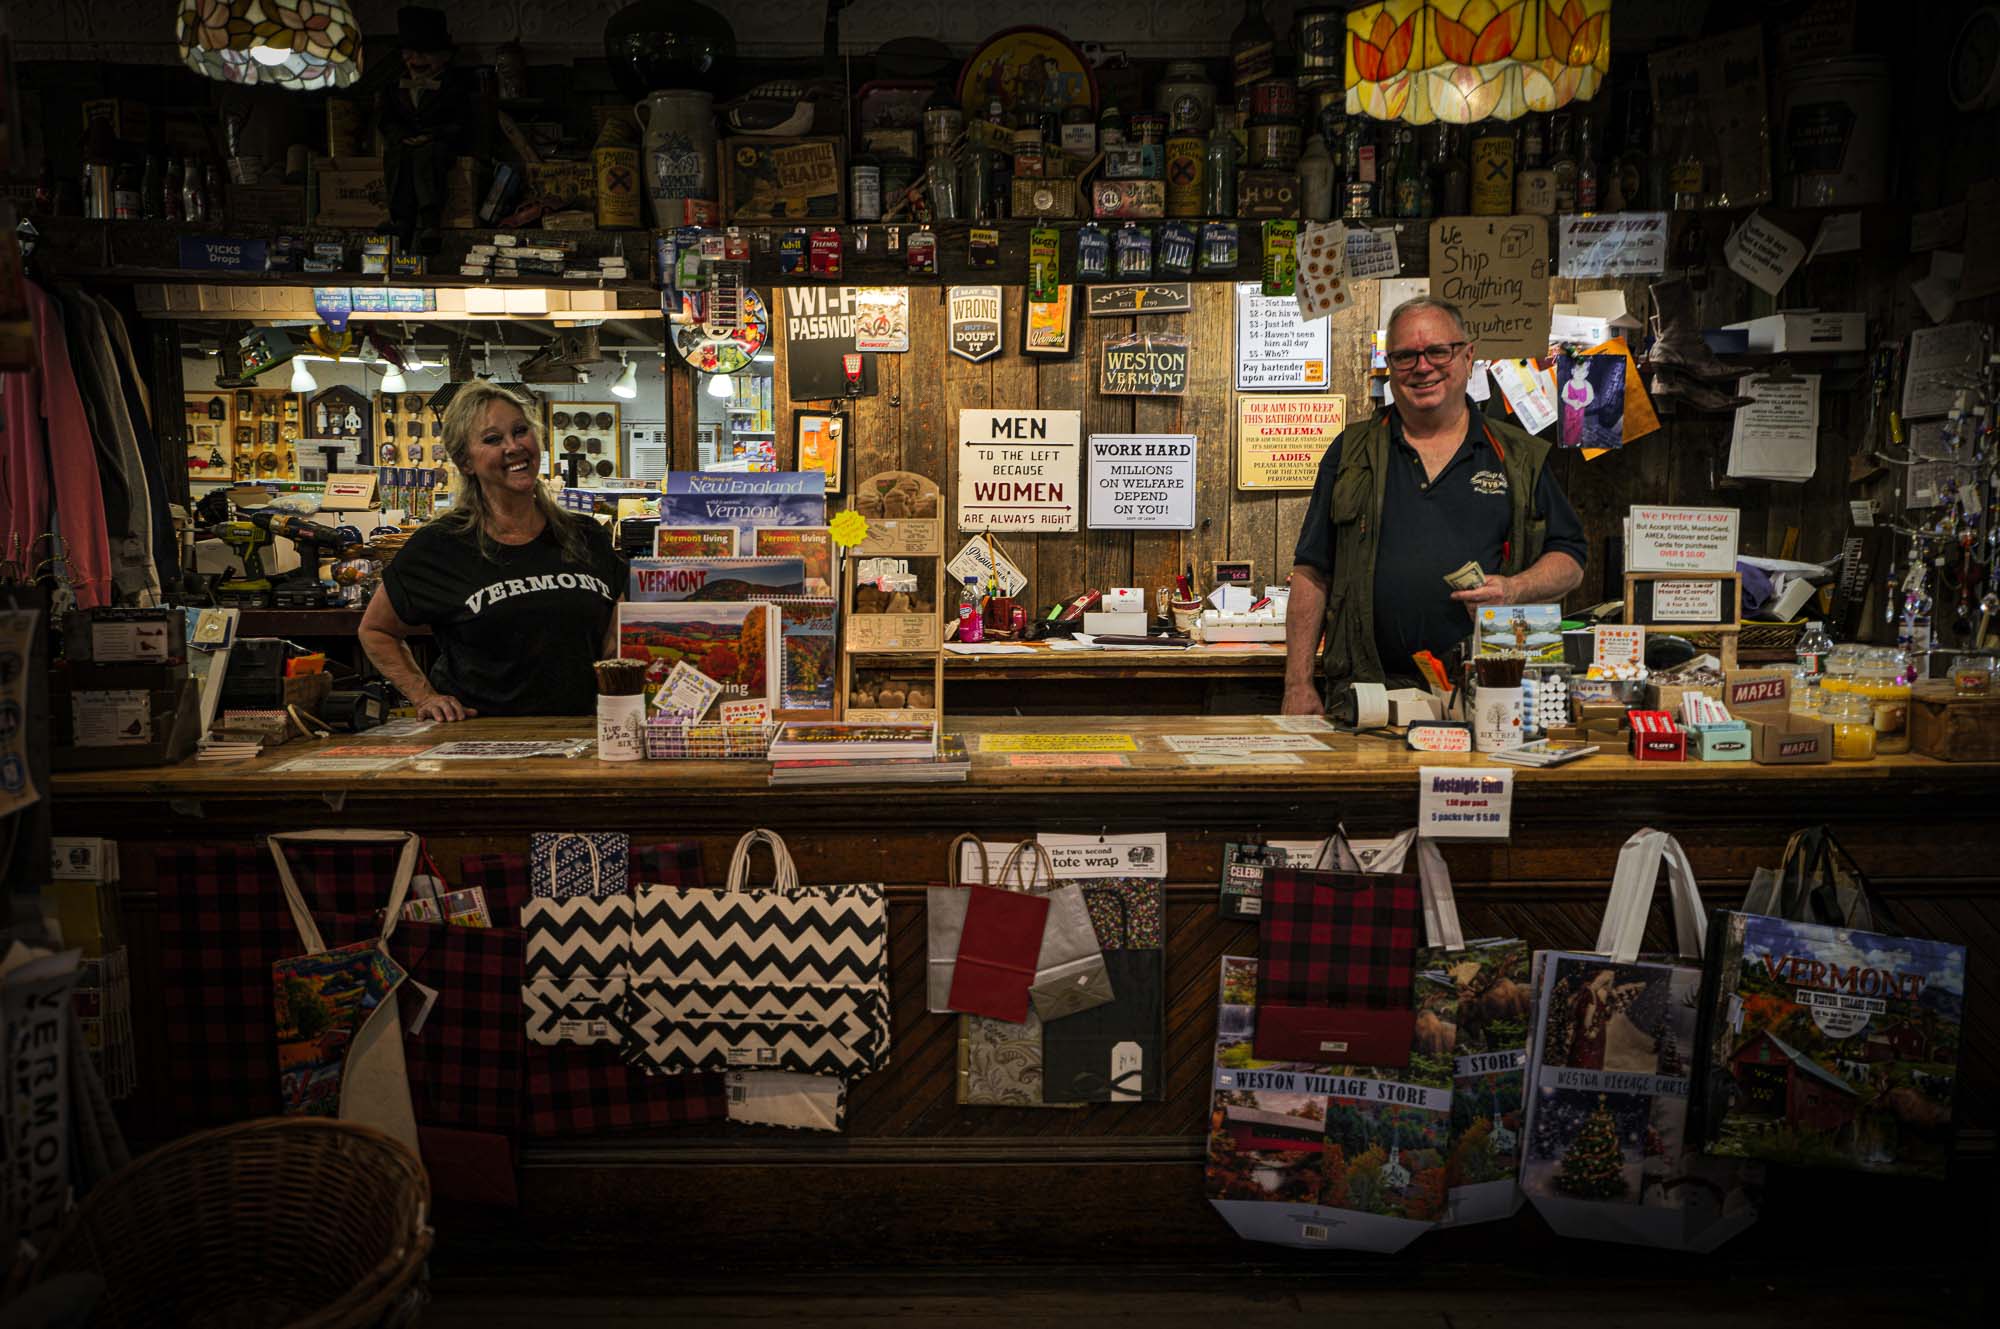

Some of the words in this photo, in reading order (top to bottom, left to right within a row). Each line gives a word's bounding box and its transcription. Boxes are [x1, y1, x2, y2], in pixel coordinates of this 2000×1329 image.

[1440, 225, 1463, 246] We
[205, 243, 240, 255] VICKS
[781, 241, 801, 251] Advil
[812, 241, 838, 249] TYLENOL
[209, 254, 240, 266] Drops
[394, 255, 417, 266] Advil
[1442, 247, 1489, 279] Ship
[1095, 285, 1185, 304] WESTON
[1443, 277, 1523, 308] Anything
[788, 287, 856, 316] WI-F
[953, 299, 997, 321] WRONG
[1265, 321, 1280, 330] Just
[1282, 320, 1294, 328] left
[1464, 316, 1534, 342] nywhere
[956, 332, 995, 342] DOUBT
[1031, 331, 1064, 346] Vermont
[968, 342, 983, 352] IT
[1295, 340, 1309, 348] day
[1107, 352, 1185, 371] WESTON
[1243, 363, 1258, 373] Pay
[1262, 363, 1303, 372] bartender
[1105, 372, 1185, 385] VERMONT
[1243, 375, 1264, 383] upon
[1268, 373, 1301, 381] arrival!
[1251, 403, 1269, 413] OUR
[1270, 403, 1286, 413] AIM
[1288, 403, 1297, 412] IS
[1299, 403, 1311, 412] TO
[1313, 403, 1334, 412] KEEP
[1244, 414, 1263, 424] THIS
[1265, 414, 1313, 423] BATHROOM
[1314, 413, 1341, 423] CLEAN
[991, 417, 1046, 439] MEN
[1260, 427, 1323, 436] GENTLEMEN
[978, 450, 994, 461] TO
[1002, 450, 1024, 461] THE
[1030, 450, 1060, 461] LEFT
[1094, 444, 1141, 457] WORK
[1145, 444, 1191, 456] HARD
[1272, 453, 1311, 461] LADIES
[992, 465, 1044, 476] BECAUSE
[1110, 465, 1173, 476] MILLIONS
[687, 480, 730, 493] New
[730, 479, 803, 494] England
[1099, 478, 1120, 488] ON
[1124, 478, 1184, 488] WELFARE
[974, 482, 1063, 502] WOMEN
[1114, 491, 1168, 501] DEPEND
[705, 504, 779, 518] Vermont
[1113, 505, 1135, 515] ON
[1138, 504, 1169, 515] YOU!
[964, 514, 984, 524] ARE
[990, 514, 1035, 524] ALWAYS
[1041, 514, 1072, 524] RIGHT
[1661, 512, 1693, 521] Prefer
[703, 534, 728, 545] living
[801, 534, 827, 545] living
[1684, 542, 1718, 550] purchases
[637, 570, 708, 592] VERMONT
[464, 572, 614, 615] VERMONT
[1735, 680, 1784, 703] MAPLE
[1782, 739, 1818, 755] MAPLE
[1432, 775, 1480, 795] Nostalgic
[1481, 777, 1504, 794] Gum
[1460, 799, 1471, 808] per
[1472, 799, 1488, 807] pack
[1438, 812, 1462, 822] packs
[1463, 812, 1475, 821] for
[1053, 857, 1081, 867] tote
[1085, 856, 1120, 868] wrap
[1764, 953, 1925, 1001] VERMONT
[1471, 1054, 1518, 1072] STORE
[1557, 1071, 1599, 1086] WESTON
[1603, 1073, 1649, 1089] VILLAGE
[1236, 1071, 1294, 1091] WESTON
[1305, 1075, 1367, 1097] VILLAGE
[1378, 1083, 1427, 1105] STORE
[35, 985, 67, 1234] VERMONT
